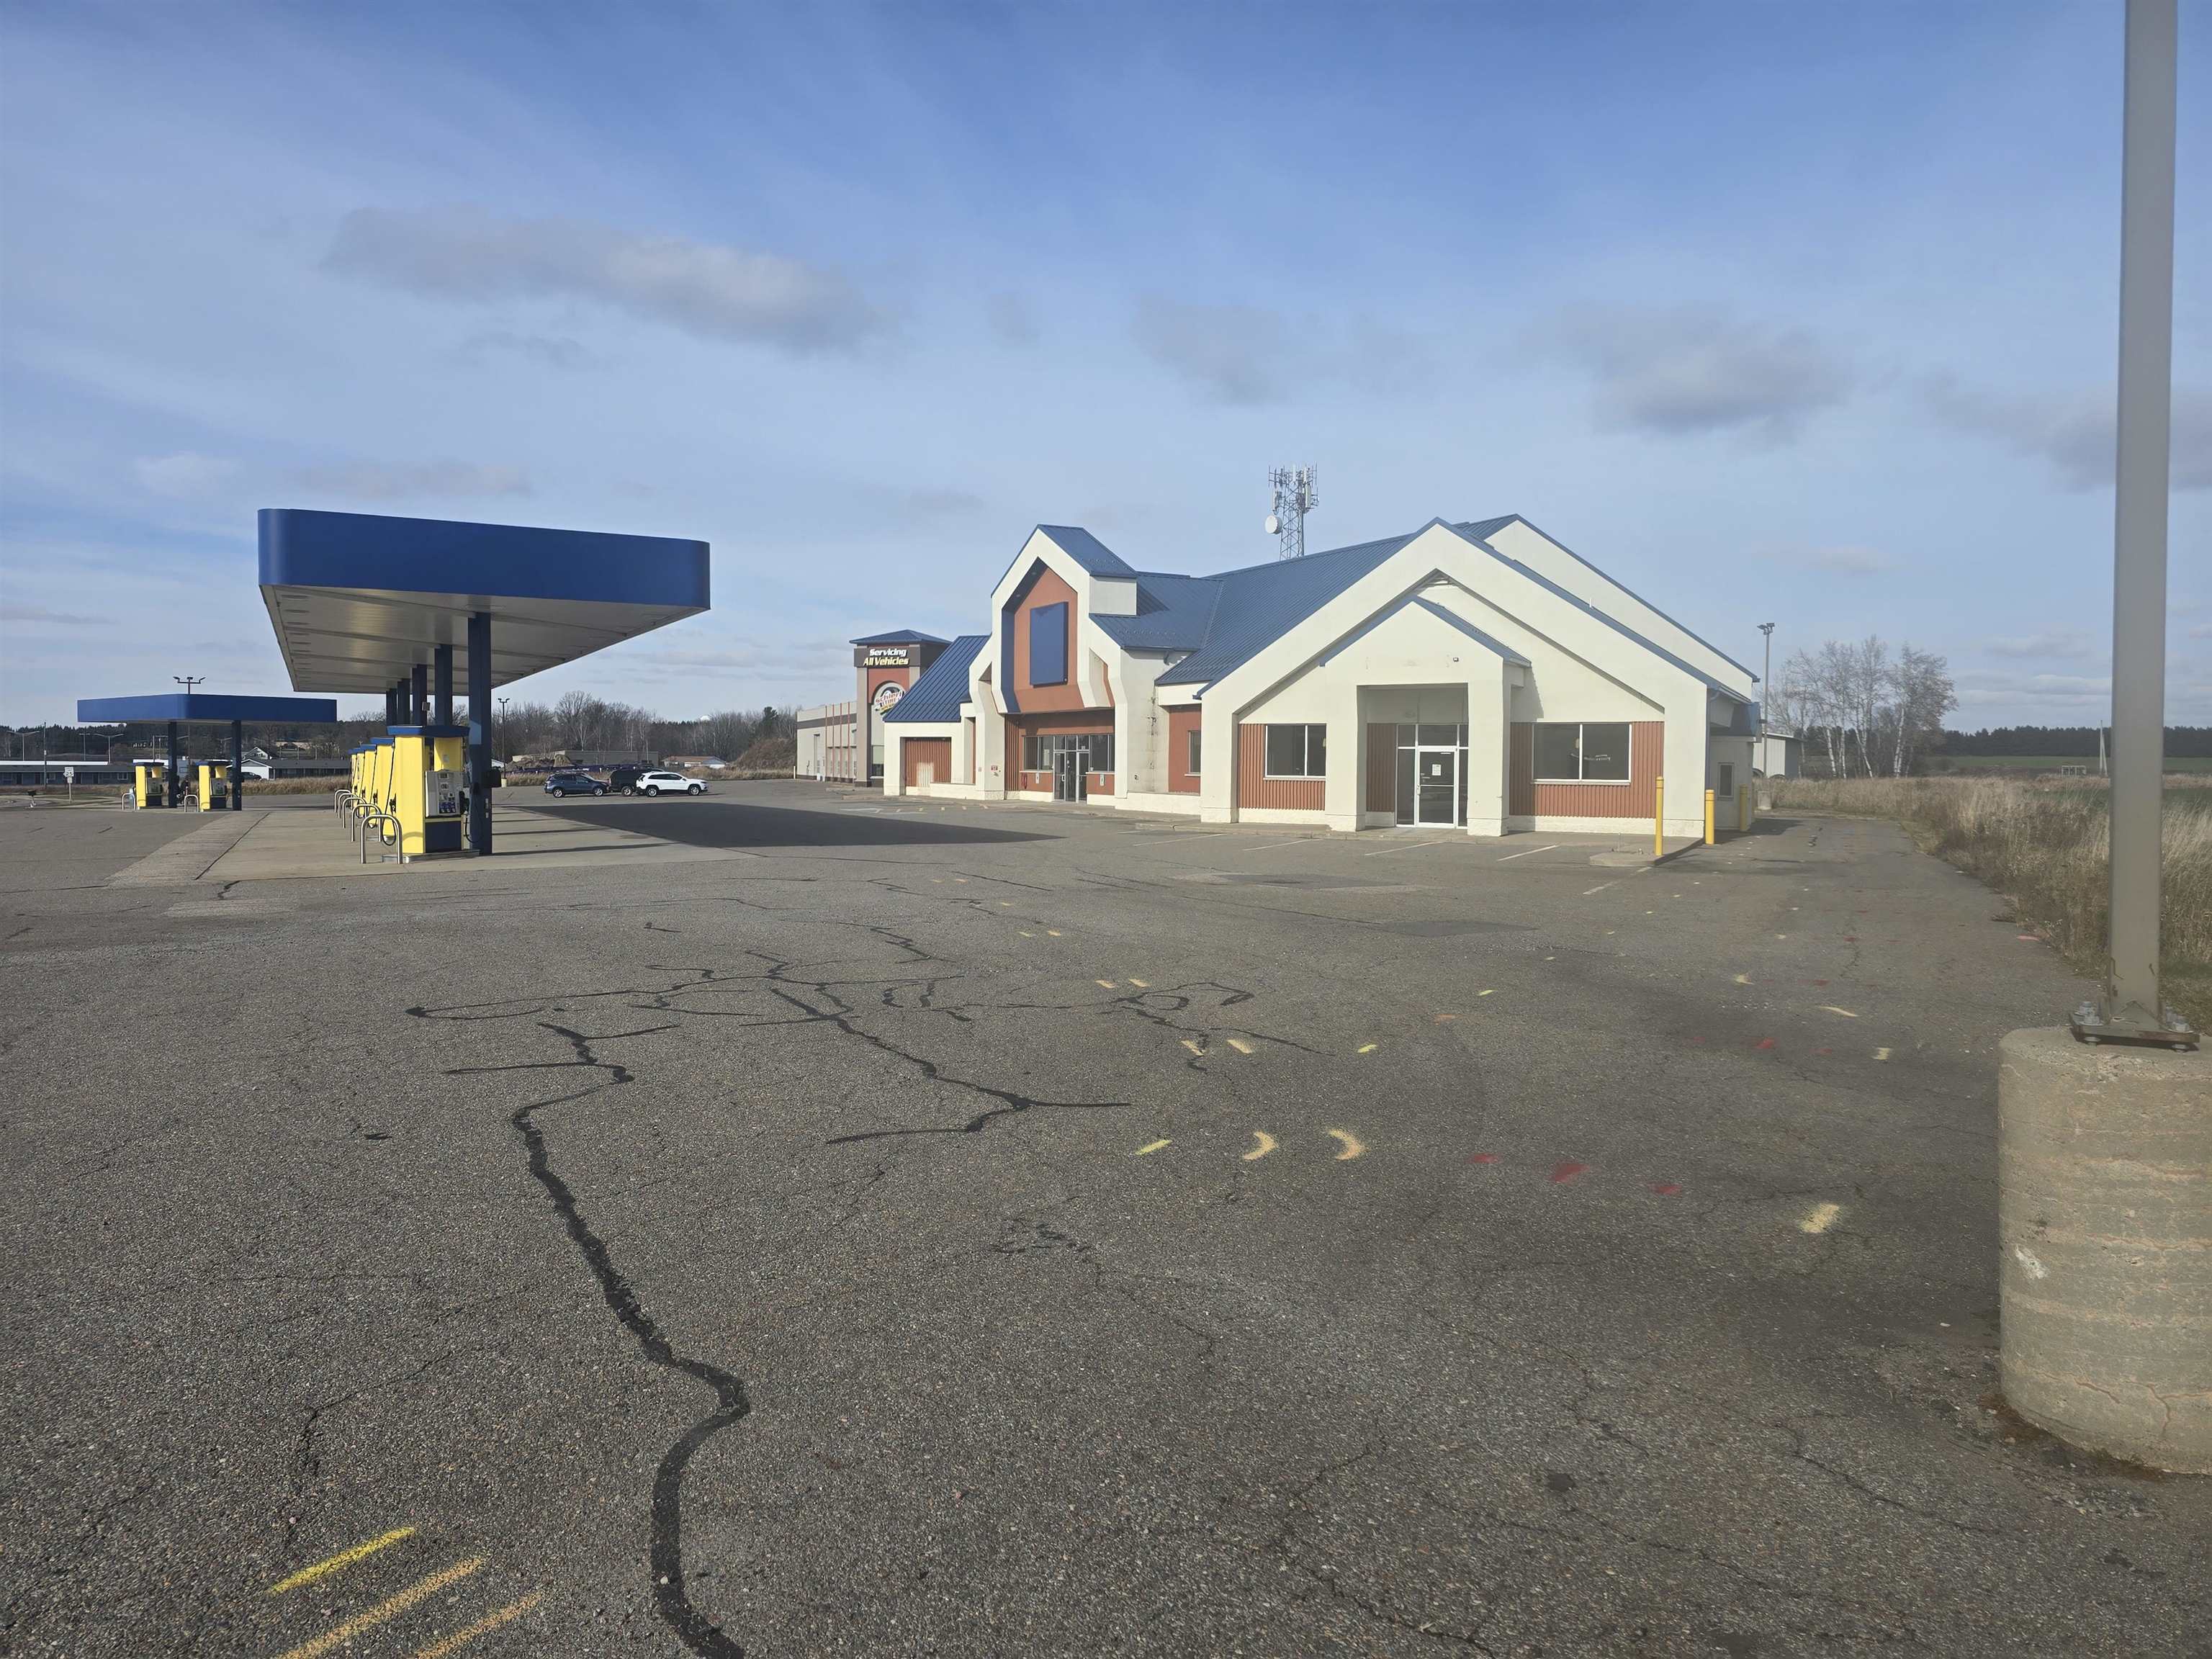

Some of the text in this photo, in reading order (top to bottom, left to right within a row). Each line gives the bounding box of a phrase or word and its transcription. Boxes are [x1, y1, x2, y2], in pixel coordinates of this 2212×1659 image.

[869, 648, 907, 657] Servicing
[863, 657, 909, 665] All Vehicles
